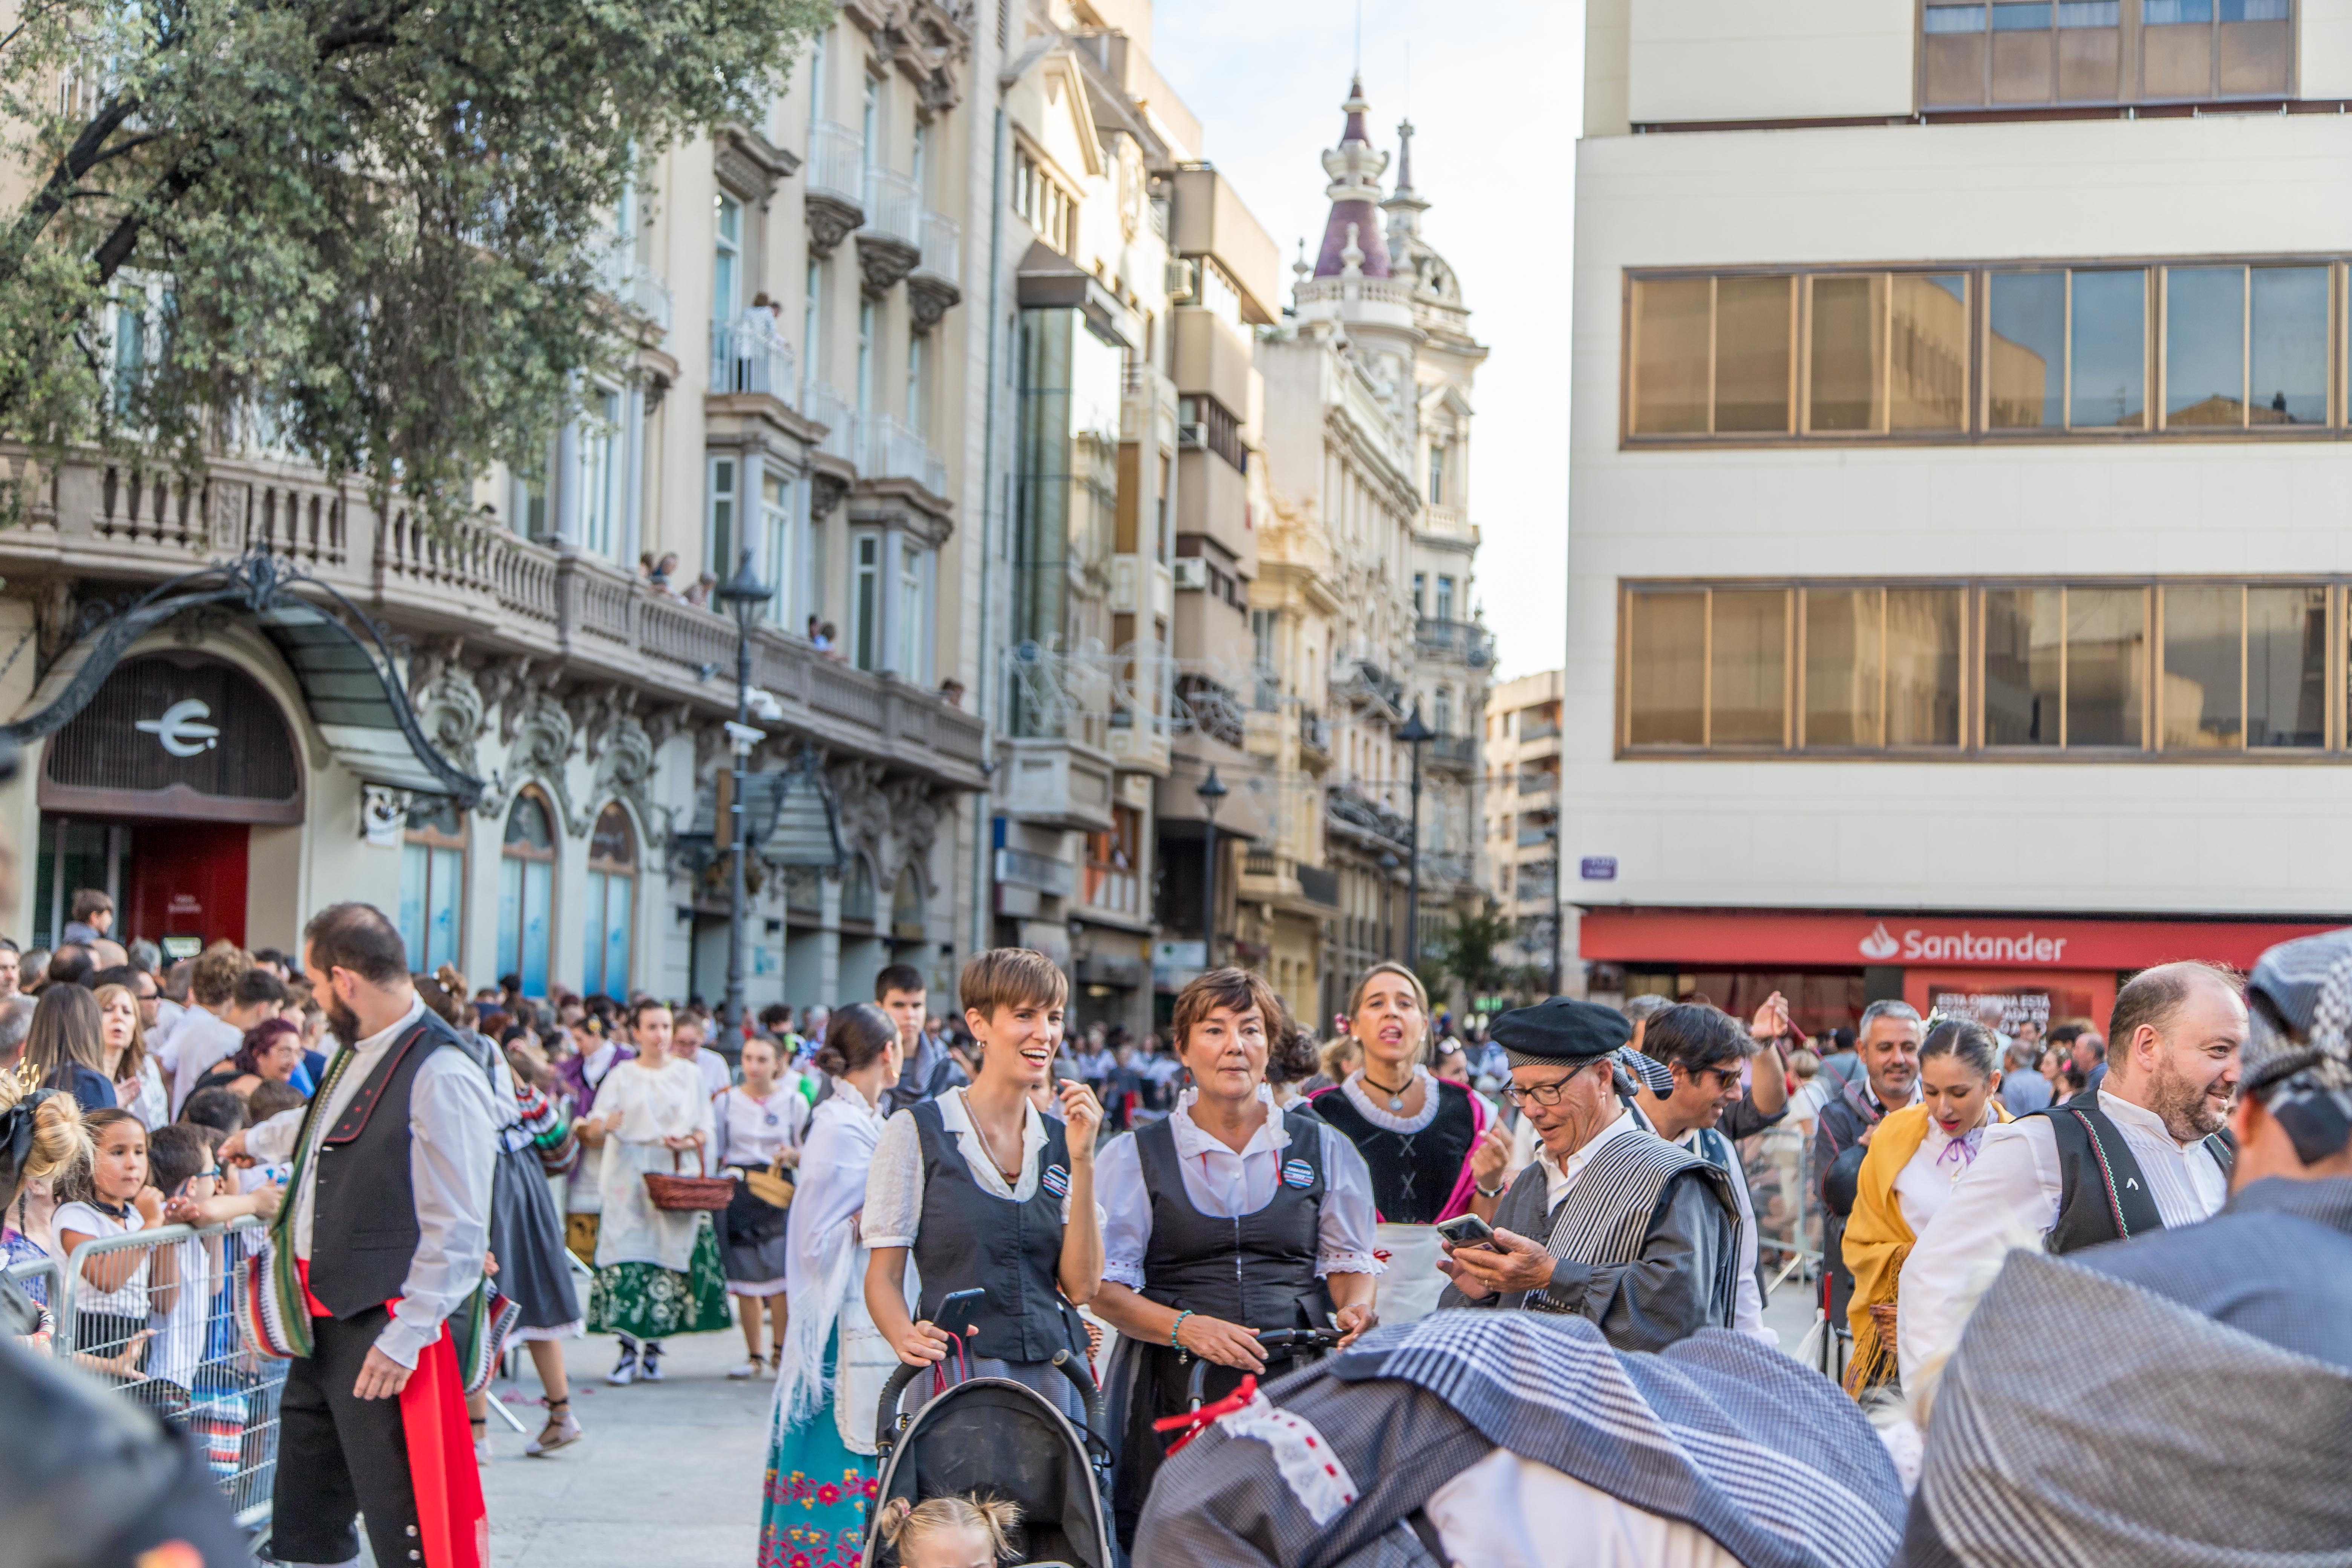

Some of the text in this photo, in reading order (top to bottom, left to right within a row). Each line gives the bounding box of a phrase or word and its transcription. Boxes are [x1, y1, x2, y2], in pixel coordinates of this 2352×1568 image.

[1903, 929, 2067, 961] Santander
[1937, 993, 1967, 1006] ESTA
[2020, 993, 2050, 1008] ESTÁ
[2031, 1008, 2049, 1021] EN
